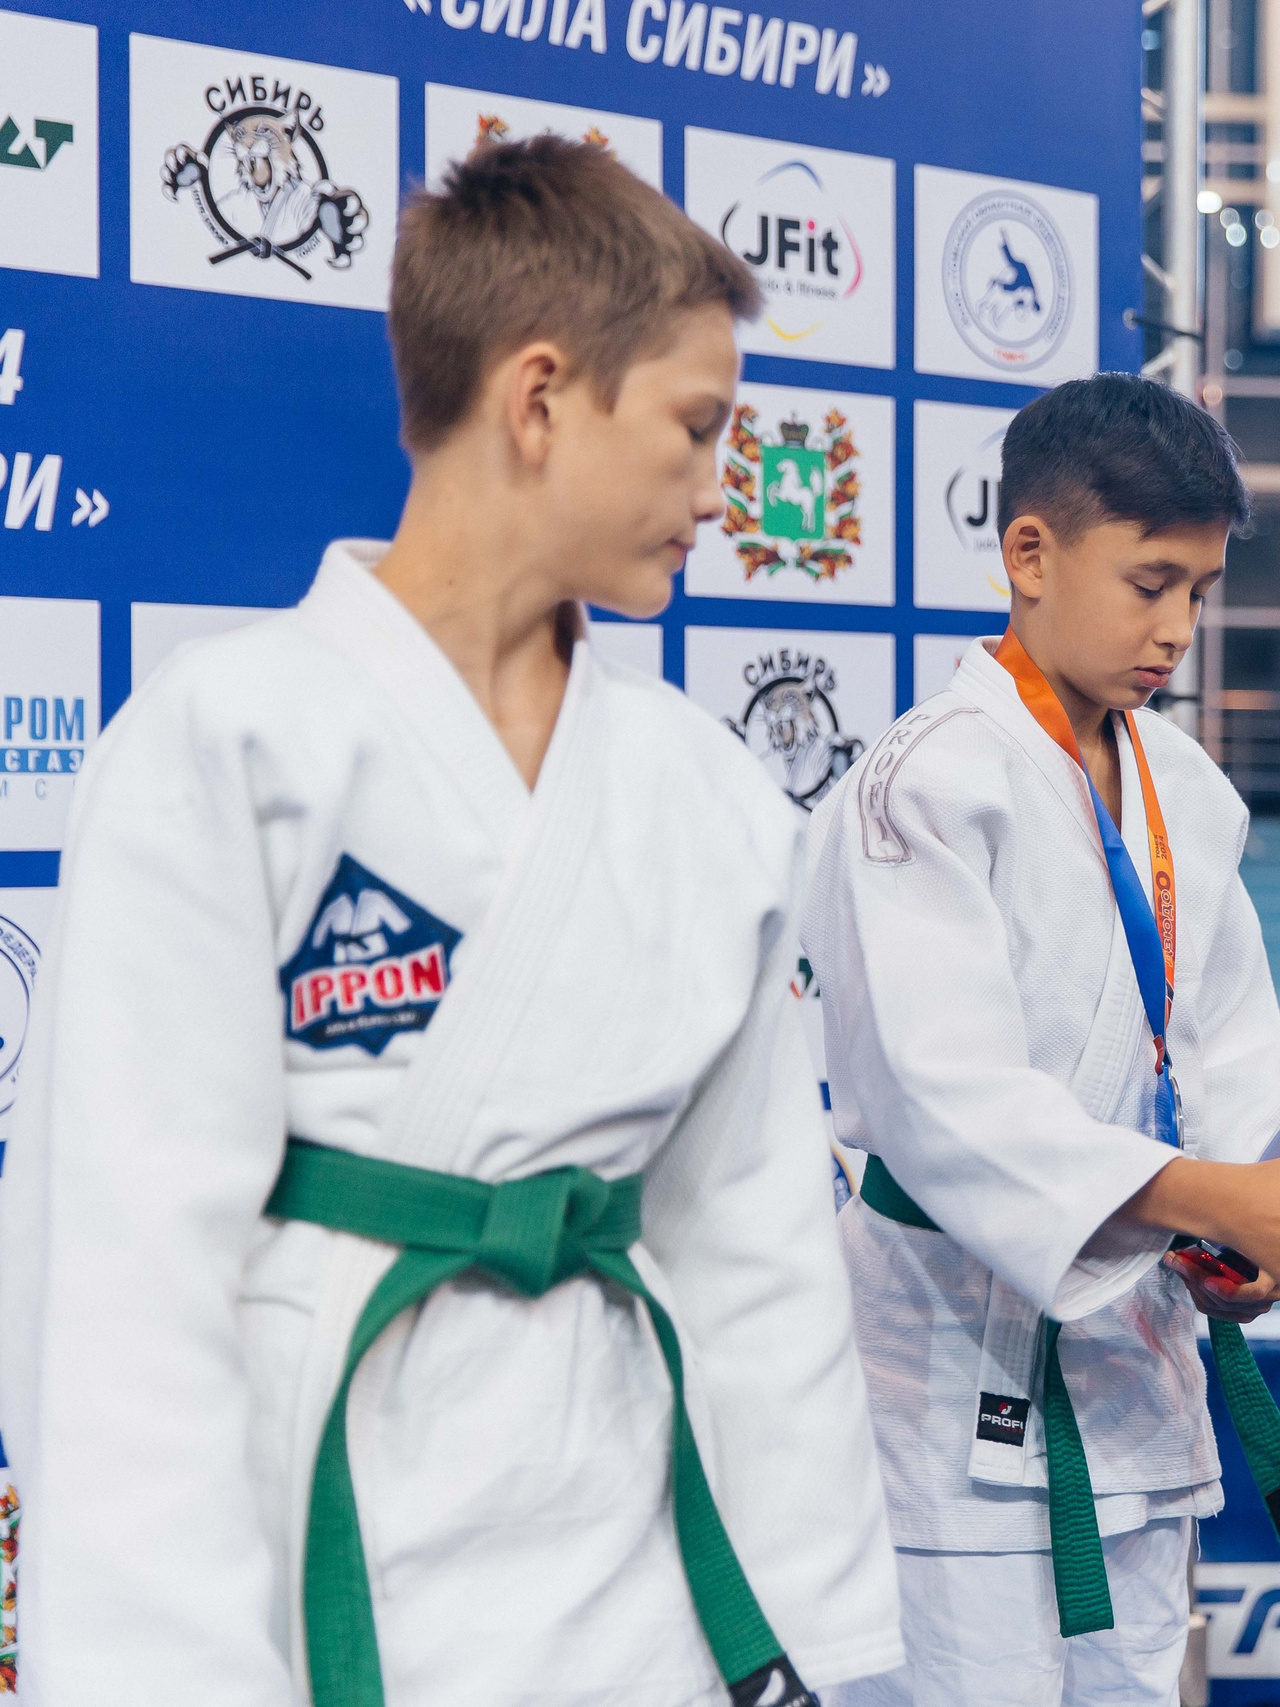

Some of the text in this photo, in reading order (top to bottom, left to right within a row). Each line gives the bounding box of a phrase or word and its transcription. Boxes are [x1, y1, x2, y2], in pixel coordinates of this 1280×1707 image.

[204, 75, 326, 132] СИБИРЬ
[743, 215, 839, 276] JFit
[744, 650, 836, 691] СИБИРЬ
[4, 697, 84, 741] РОМ
[292, 943, 445, 1035] IPPON
[980, 1413, 1024, 1430] PROFI
